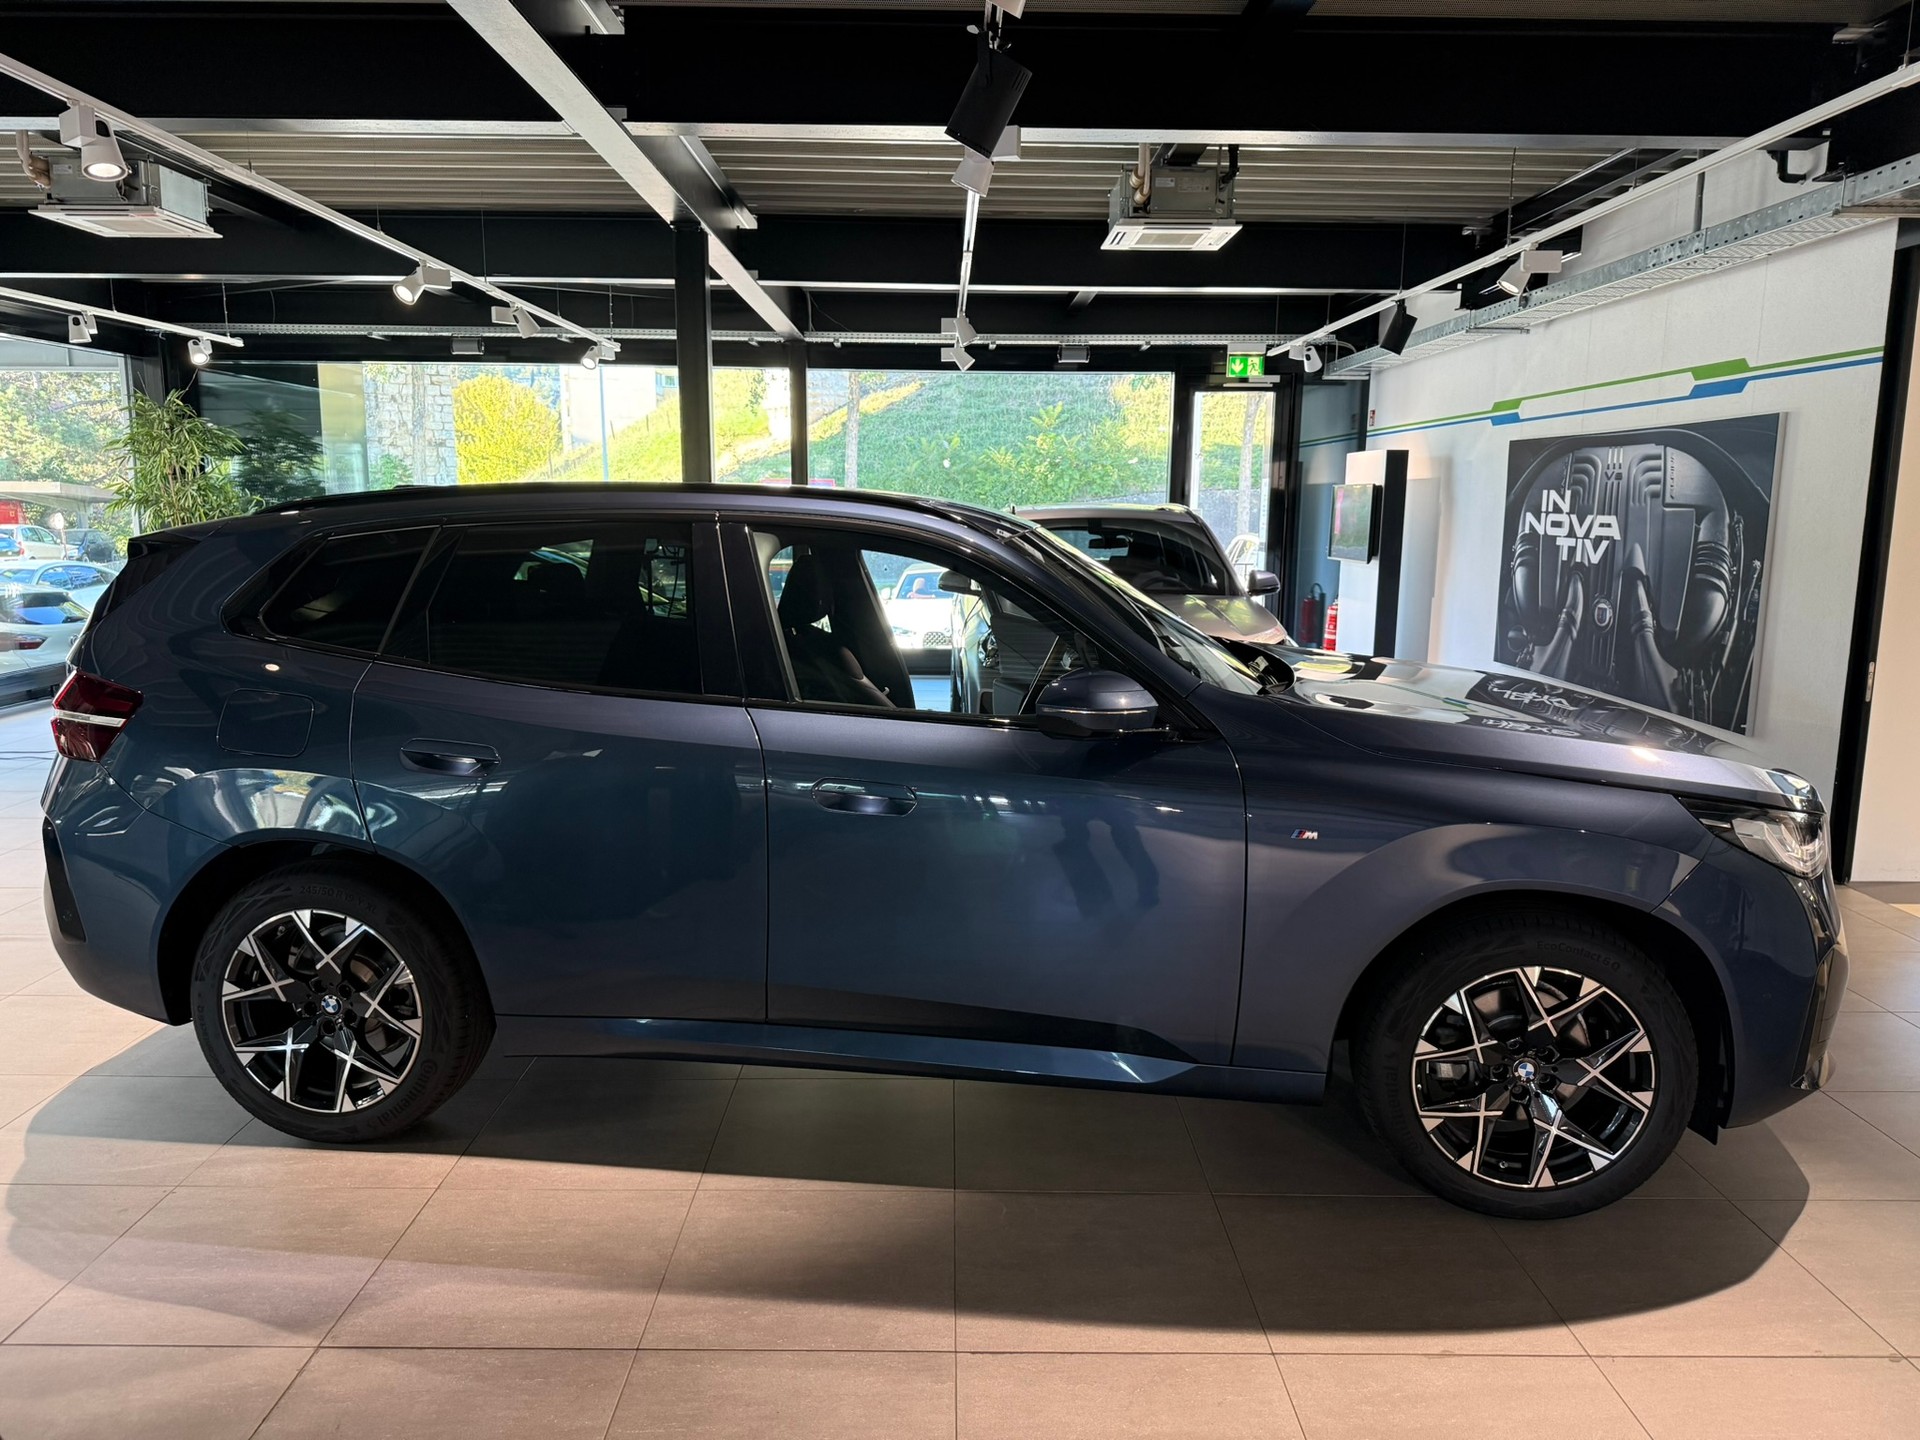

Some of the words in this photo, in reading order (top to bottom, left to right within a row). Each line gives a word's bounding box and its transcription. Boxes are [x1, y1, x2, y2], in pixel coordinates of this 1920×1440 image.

[1541, 489, 1571, 513] IN
[1524, 511, 1621, 540] NOVA
[1555, 536, 1610, 565] TIV
[300, 885, 334, 897] 245/50
[1536, 940, 1601, 962] EcoContact
